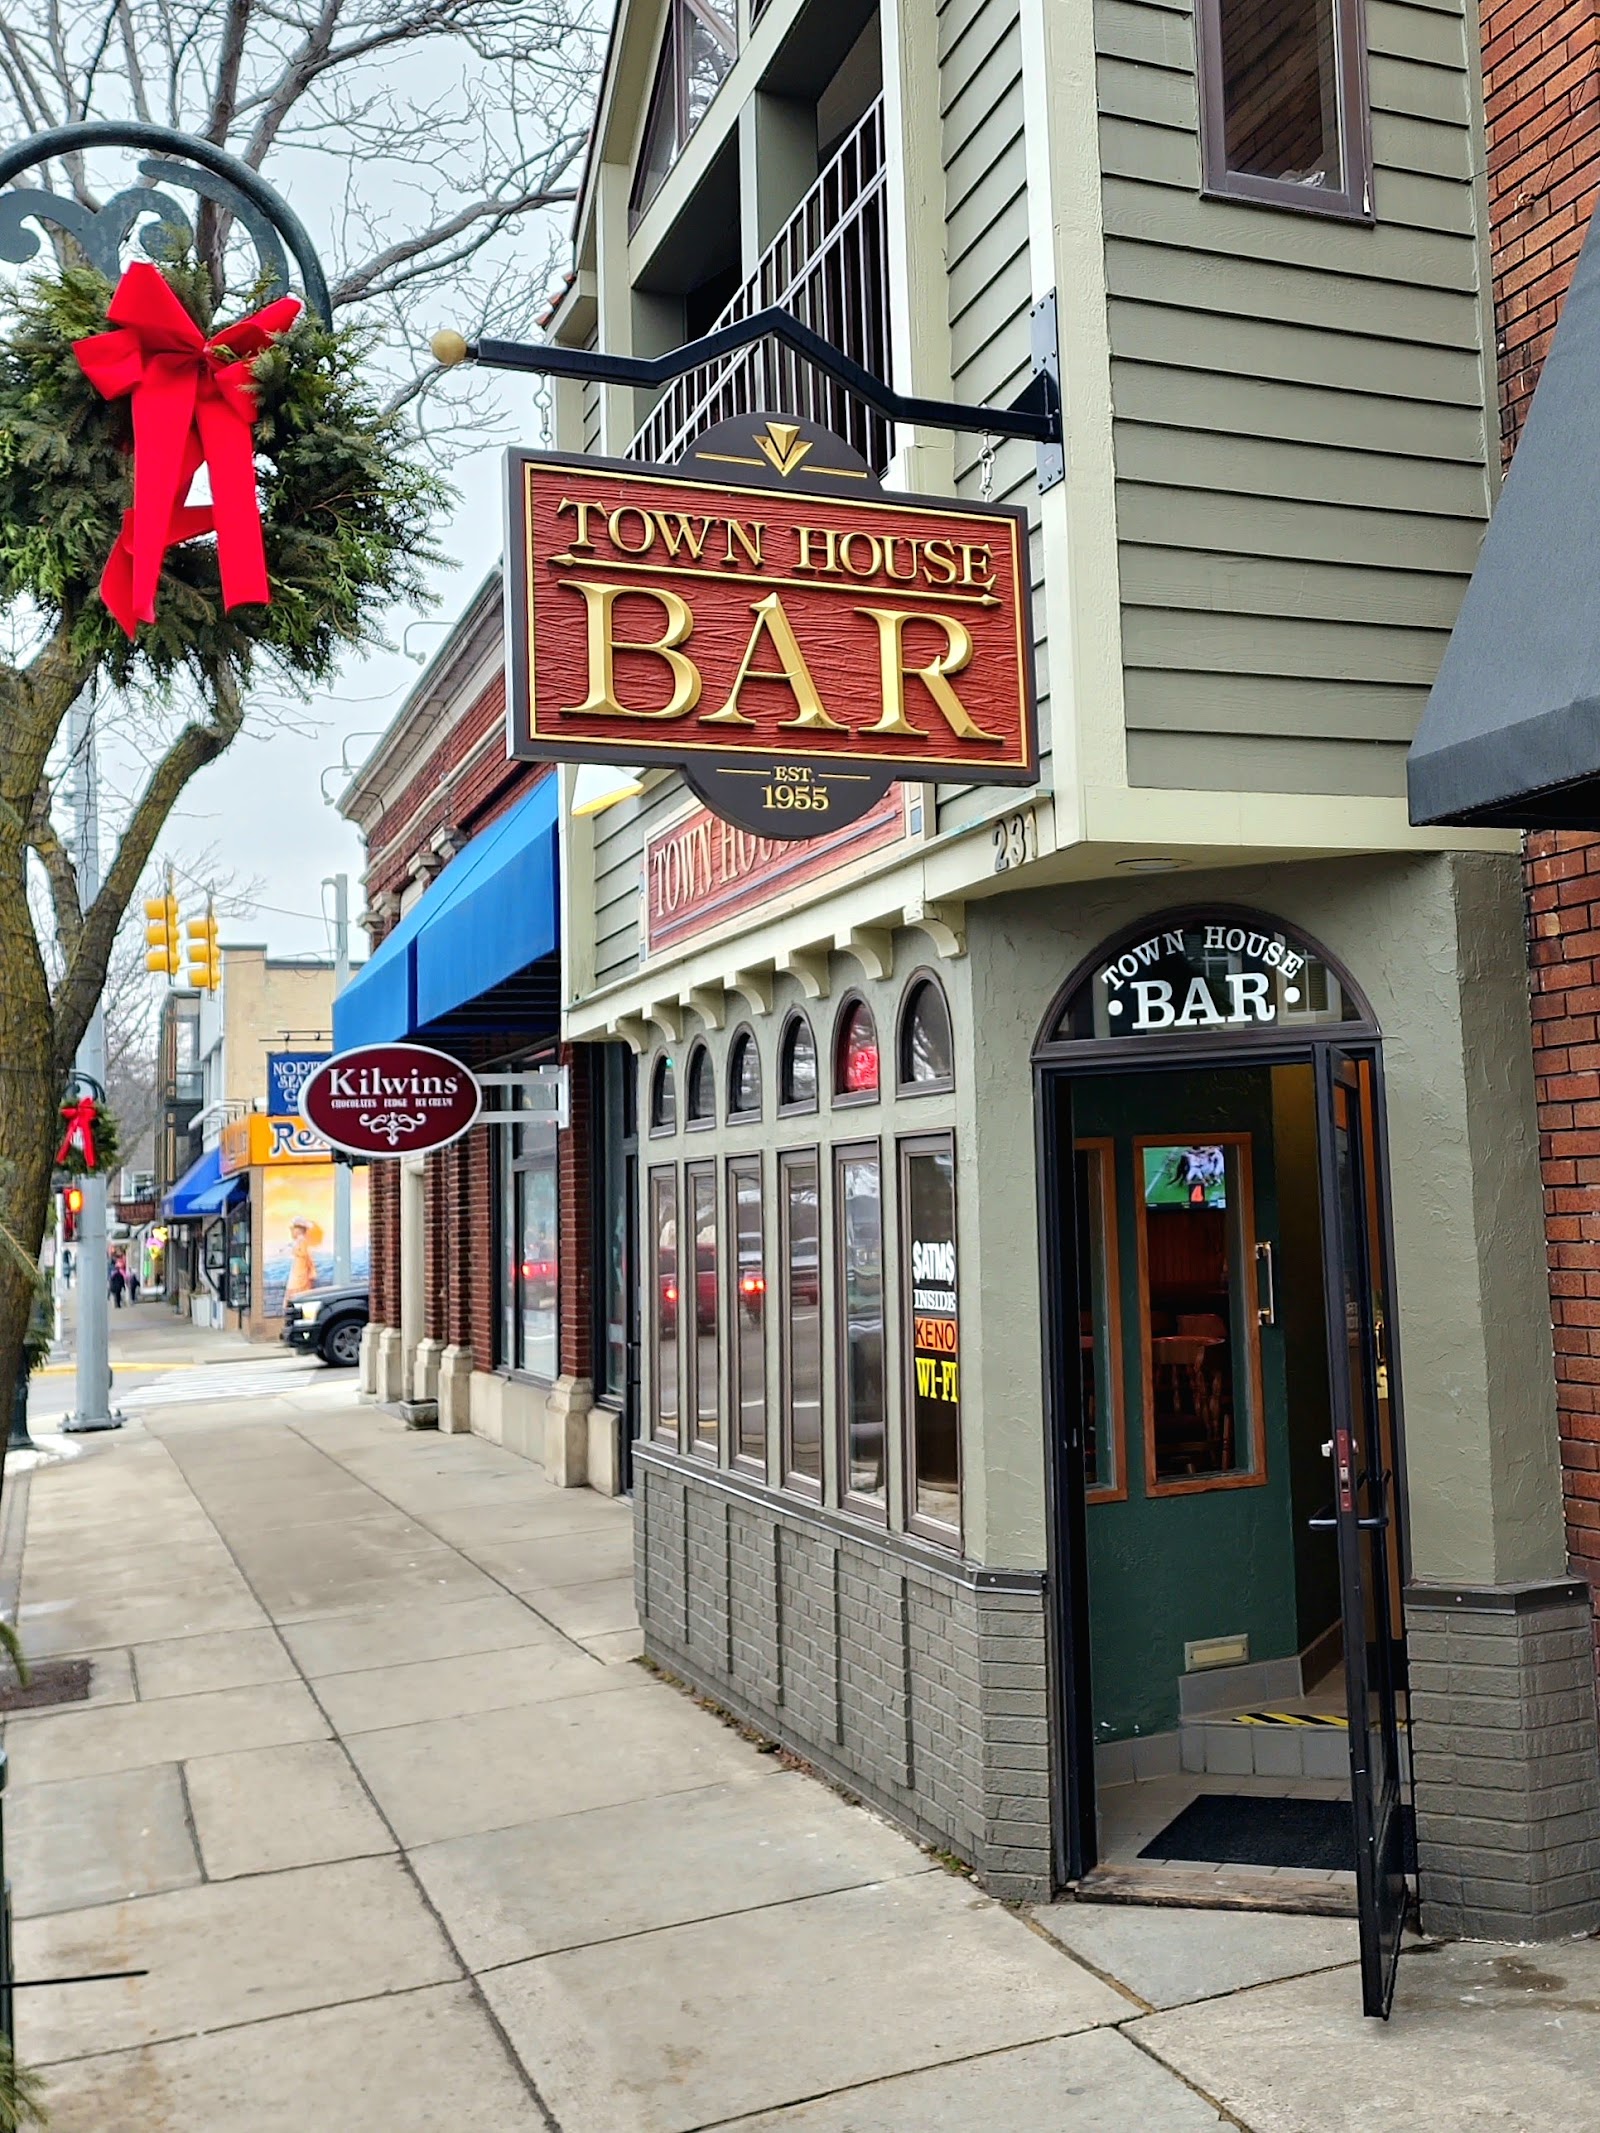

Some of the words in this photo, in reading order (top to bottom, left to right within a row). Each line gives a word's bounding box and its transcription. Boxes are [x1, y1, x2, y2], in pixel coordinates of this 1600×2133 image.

[556, 496, 766, 568] TOWN
[791, 525, 998, 592] HOUSE
[557, 579, 1006, 744] BAR
[773, 766, 815, 783] EST.
[761, 784, 829, 811] 1955
[992, 806, 1038, 872] 231
[653, 817, 716, 918] TOWN
[1101, 929, 1184, 991] TOWN
[1203, 926, 1305, 979] HOUSE
[1130, 972, 1276, 1030] BAR
[272, 1061, 323, 1077] NORT
[328, 1067, 458, 1096] Kilwins
[331, 1098, 377, 1109] CHOCOLATES
[383, 1098, 408, 1108] FUDGE
[415, 1098, 427, 1108] ICE
[428, 1097, 453, 1107] CREAM
[914, 1289, 957, 1312] INSIDE
[915, 1319, 956, 1351] KENO
[915, 1357, 959, 1403] WI-FI
